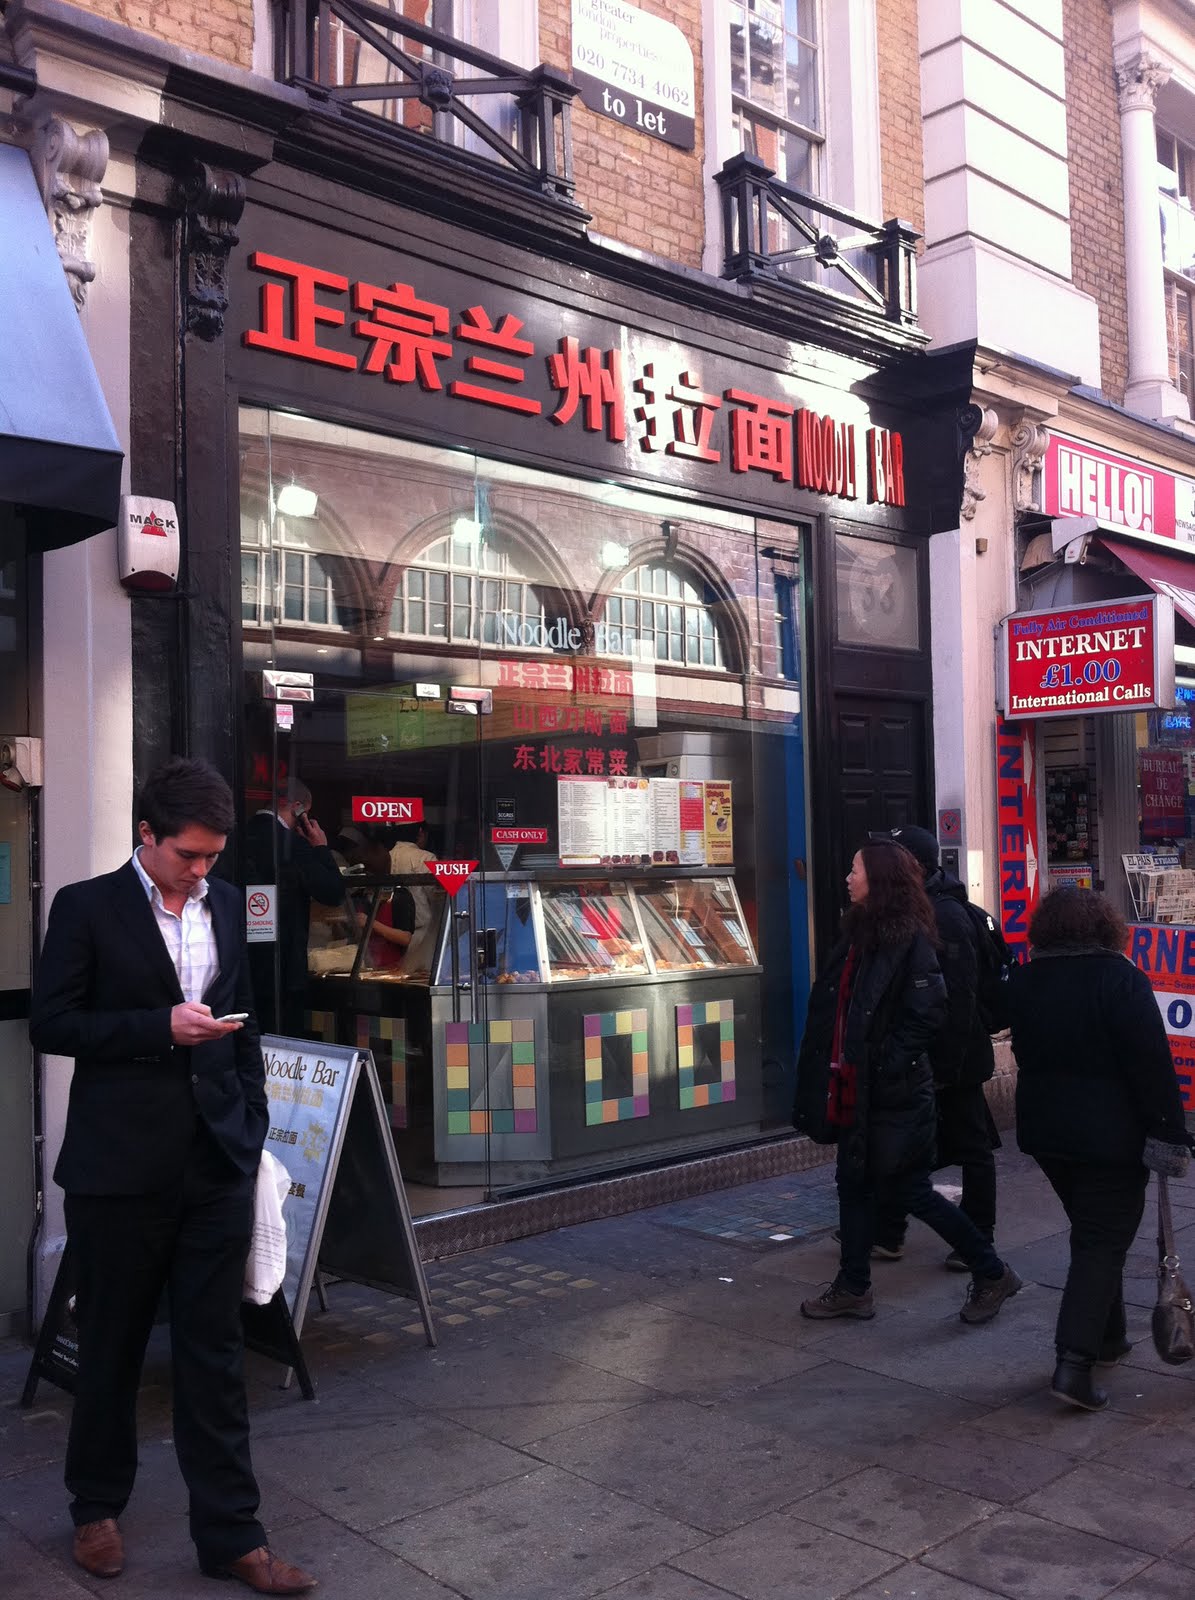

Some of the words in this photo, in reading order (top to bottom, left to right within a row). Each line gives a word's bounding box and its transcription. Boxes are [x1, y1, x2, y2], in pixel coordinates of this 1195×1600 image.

[577, 44, 605, 70] 020
[612, 60, 645, 89] 7734
[653, 80, 690, 107] 4062
[602, 87, 626, 118] to
[635, 99, 667, 135] let
[243, 250, 795, 483] 正宗兰州拉面
[796, 408, 864, 500] NOODL
[866, 427, 905, 507] BAR
[1061, 451, 1153, 533] HELLO!
[130, 513, 176, 529] MACK
[496, 612, 582, 650] Noodle
[592, 621, 634, 656] Bar
[1013, 620, 1044, 637] Fully
[1046, 618, 1067, 632] Air
[1069, 607, 1149, 629] Conditioned
[1016, 626, 1147, 661] INTERNET
[1040, 657, 1122, 689] £1.00
[1012, 686, 1110, 709] International
[1113, 683, 1152, 701] Calls
[512, 743, 629, 776] 东北家常菜
[1142, 759, 1180, 774] BUREAU
[1156, 777, 1169, 790] DE
[361, 801, 412, 818] OPEN
[1145, 793, 1183, 808] CHANGE
[496, 830, 519, 839] CASH
[520, 831, 545, 840] ONLY
[435, 863, 470, 876] PUSH
[311, 1060, 340, 1087] Bar
